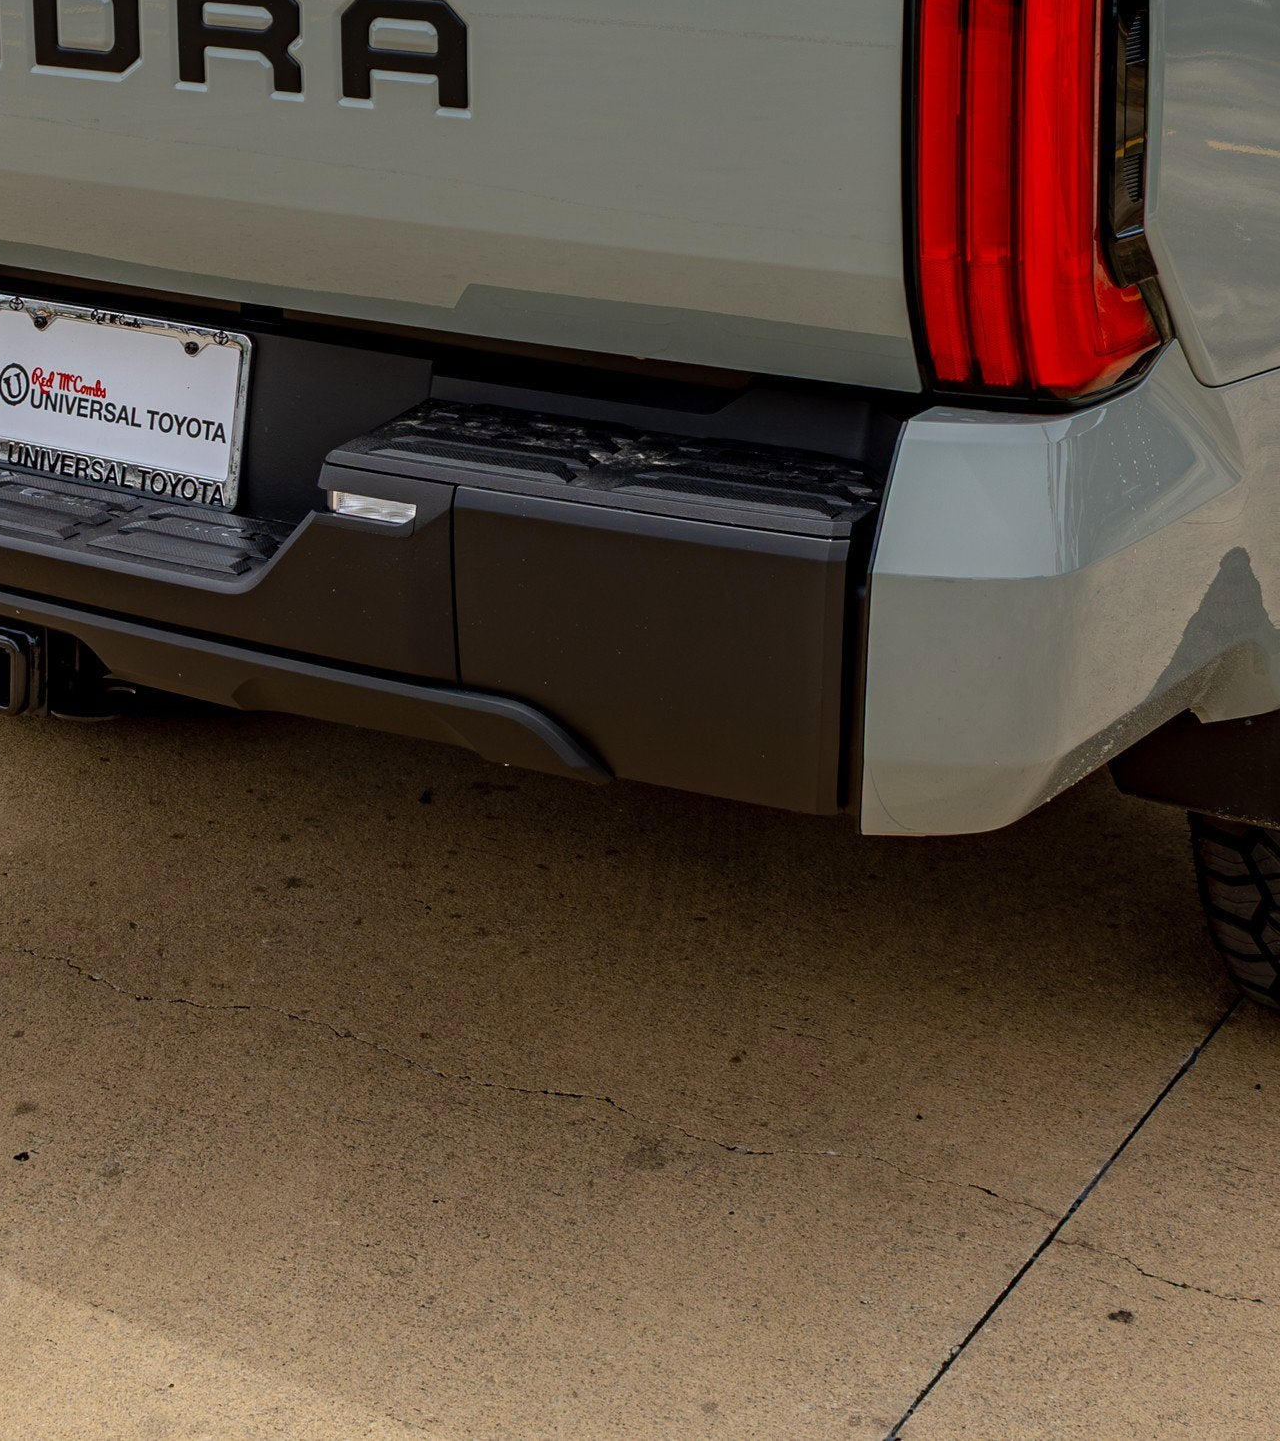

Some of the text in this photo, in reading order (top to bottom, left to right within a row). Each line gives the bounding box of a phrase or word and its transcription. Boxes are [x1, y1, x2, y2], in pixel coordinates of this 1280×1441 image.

[31, 366, 107, 399] Red McCombs
[30, 389, 227, 444] UNIVERSAL TOYOTA
[7, 441, 226, 507] UNIVERSAL TOYOTA
